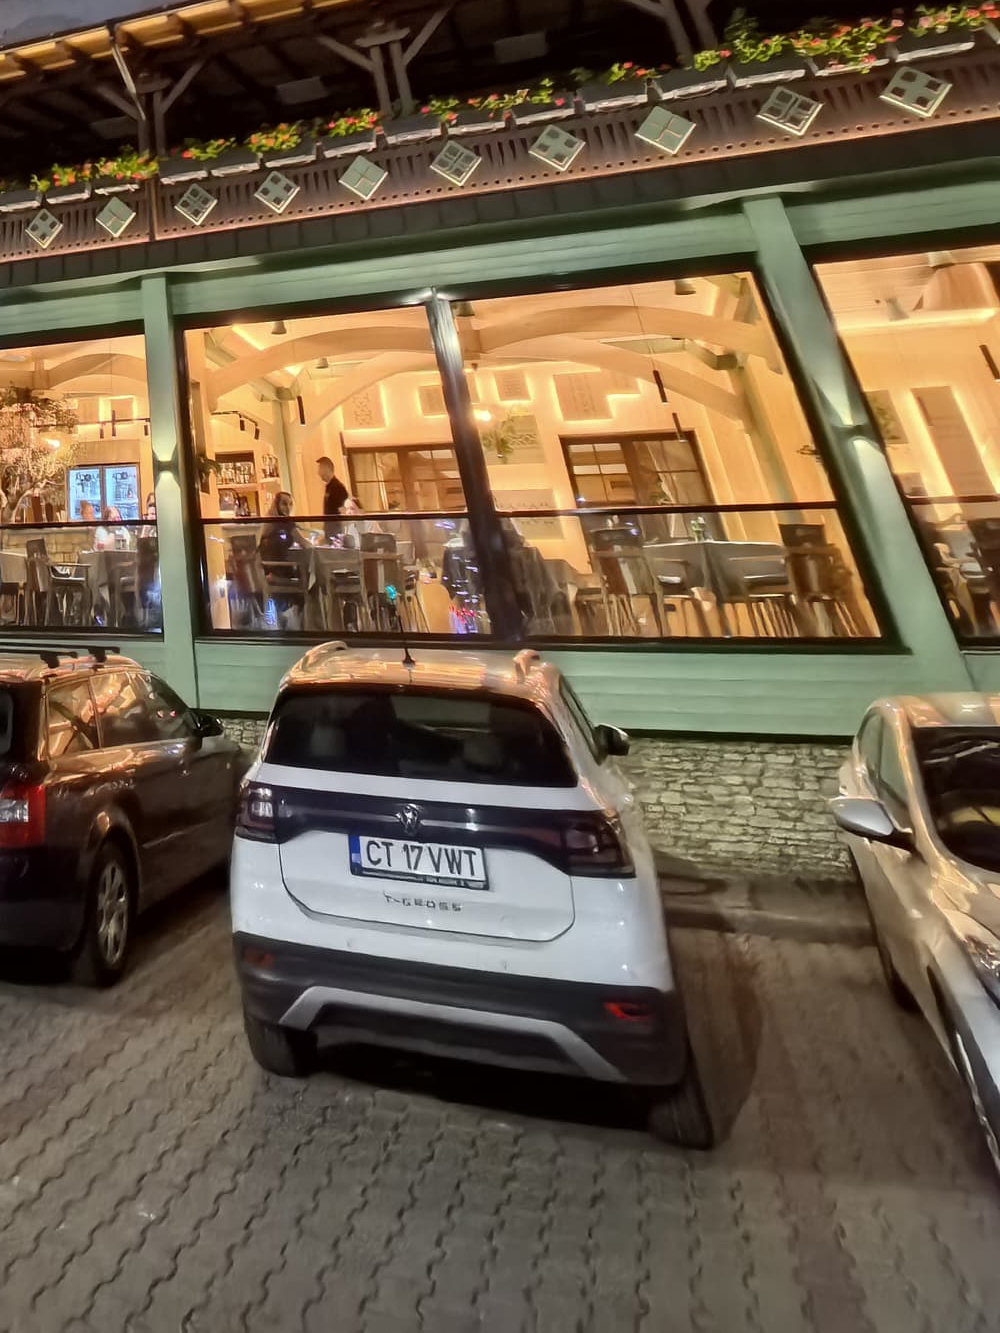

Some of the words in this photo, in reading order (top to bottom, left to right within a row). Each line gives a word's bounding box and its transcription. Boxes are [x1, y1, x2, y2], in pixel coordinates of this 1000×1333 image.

[366, 840, 394, 868] CT
[402, 843, 424, 871] 17
[427, 846, 477, 877] VWT
